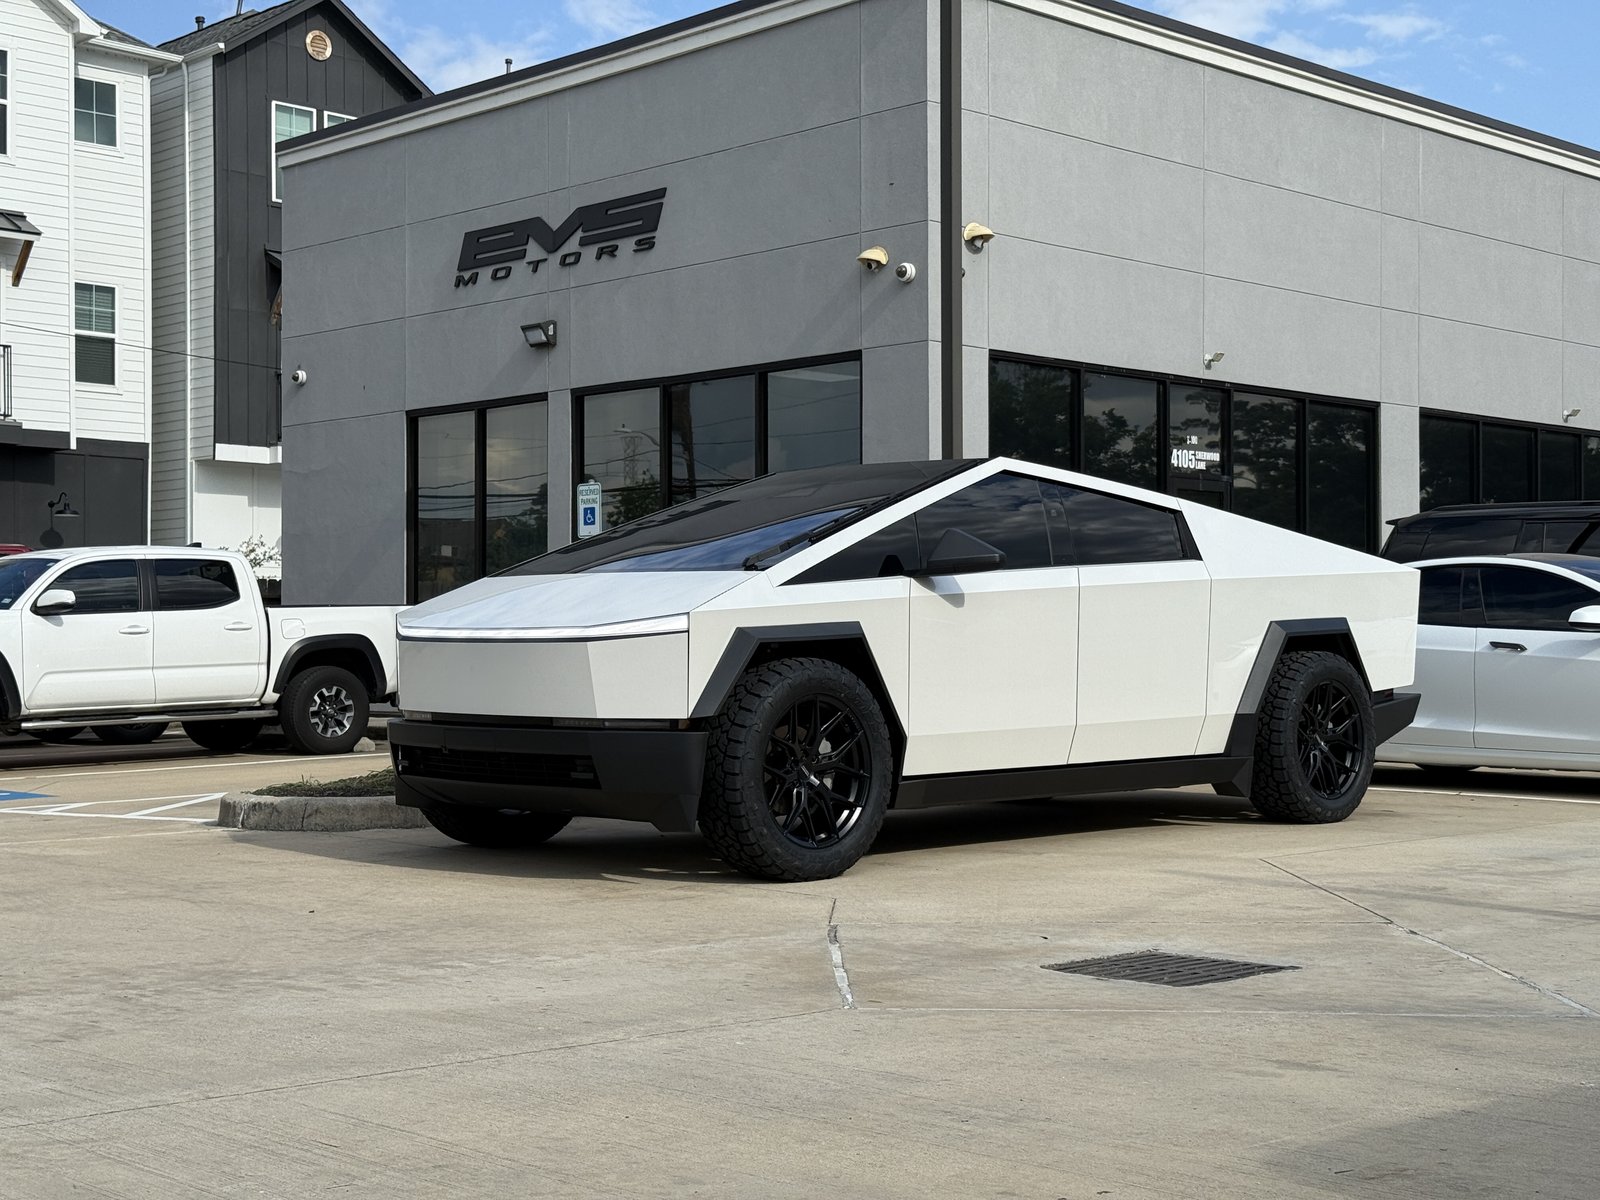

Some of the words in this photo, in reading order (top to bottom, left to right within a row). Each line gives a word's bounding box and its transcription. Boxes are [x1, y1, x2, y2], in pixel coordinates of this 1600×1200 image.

[457, 187, 667, 272] EVS
[454, 236, 656, 288] MOTORS
[1171, 449, 1195, 469] 4105
[579, 488, 599, 496] RESERVED
[580, 497, 598, 505] PARKING
